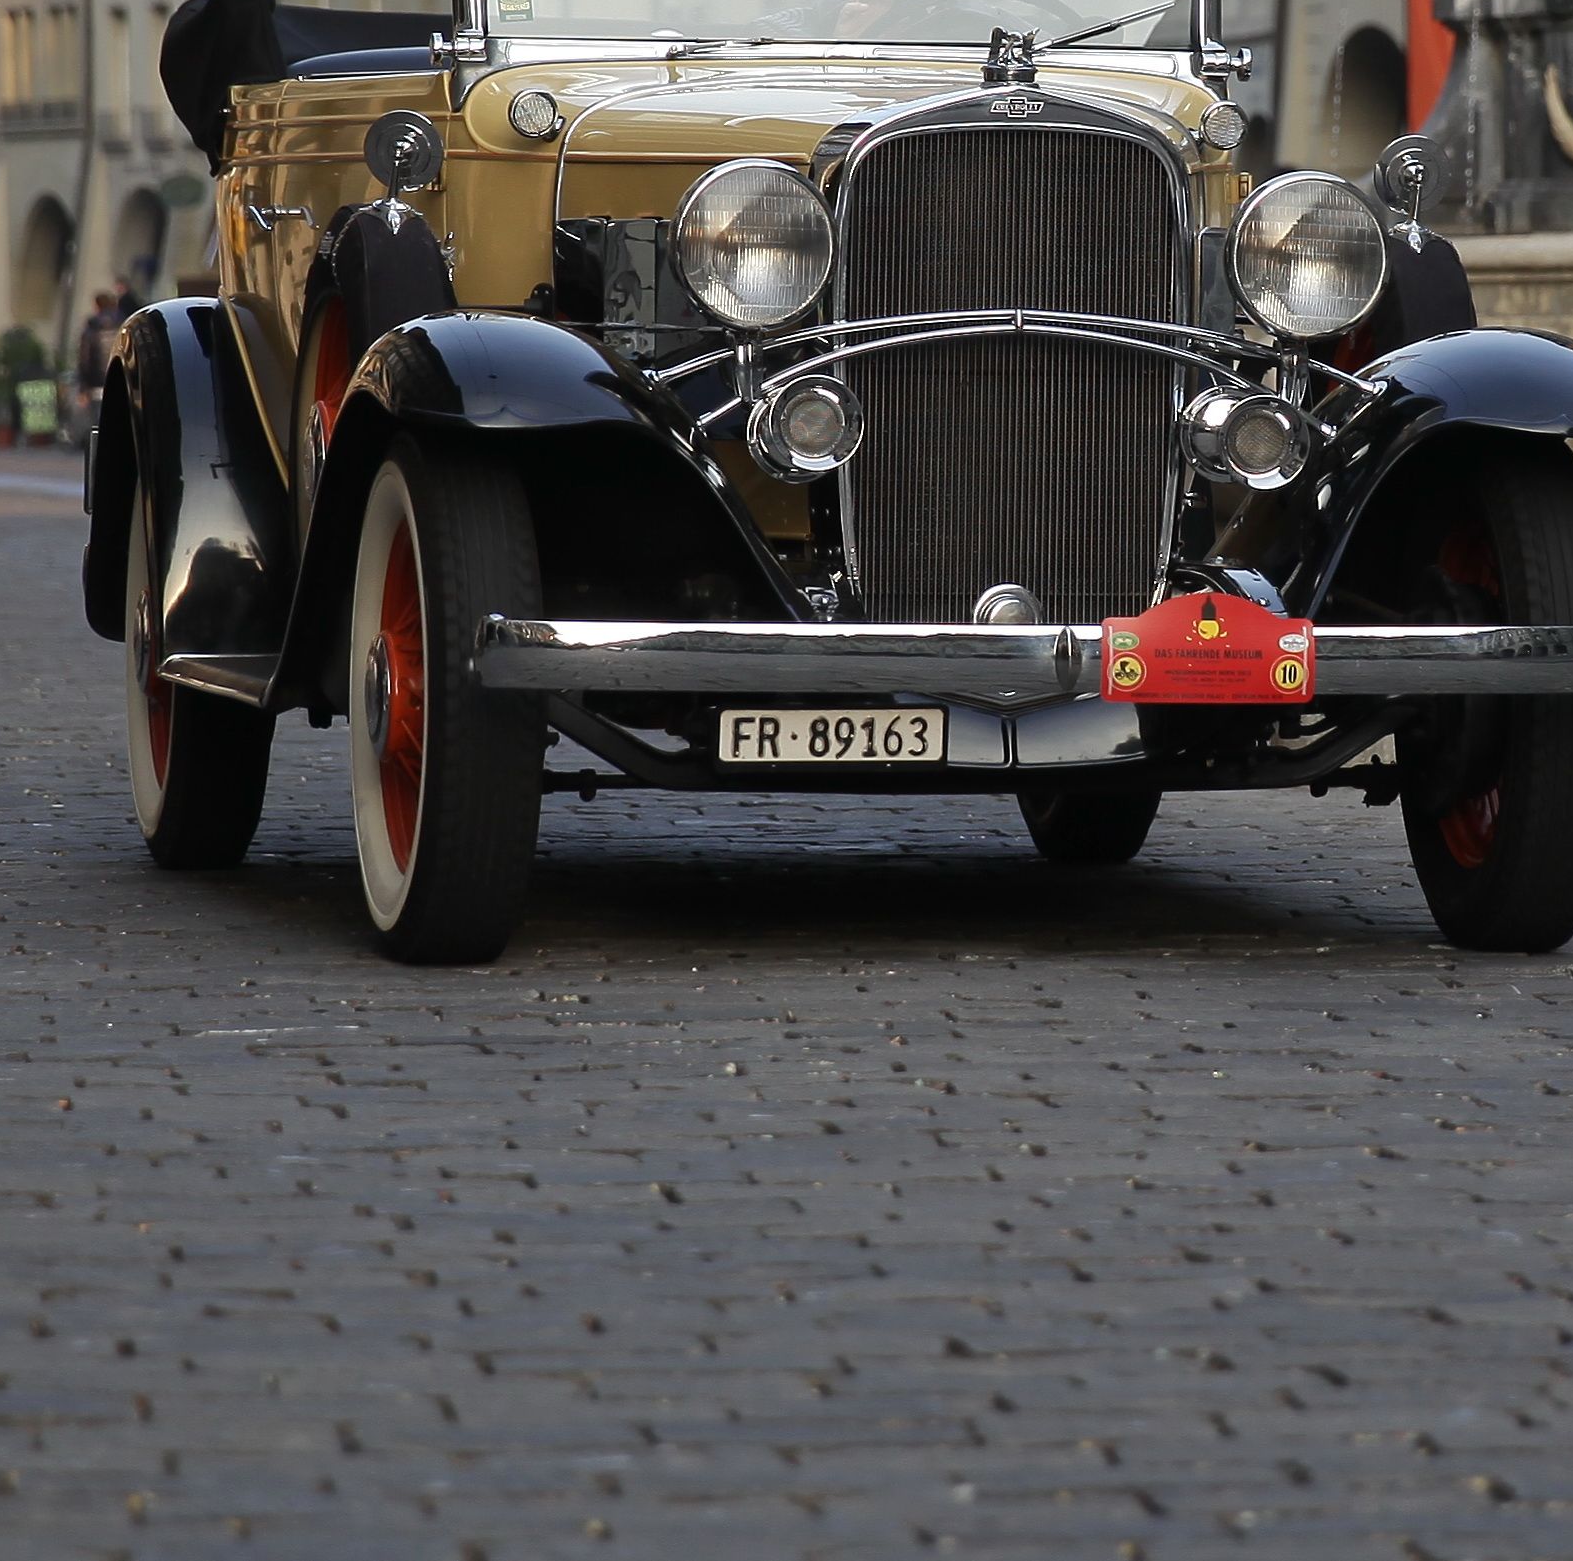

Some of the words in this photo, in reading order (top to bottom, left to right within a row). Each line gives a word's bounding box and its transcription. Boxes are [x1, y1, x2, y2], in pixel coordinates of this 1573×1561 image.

[1154, 648, 1173, 658] DAS
[1176, 648, 1220, 659] FAHRENDE
[1223, 648, 1263, 659] MUSEUM
[1281, 663, 1298, 684] 10
